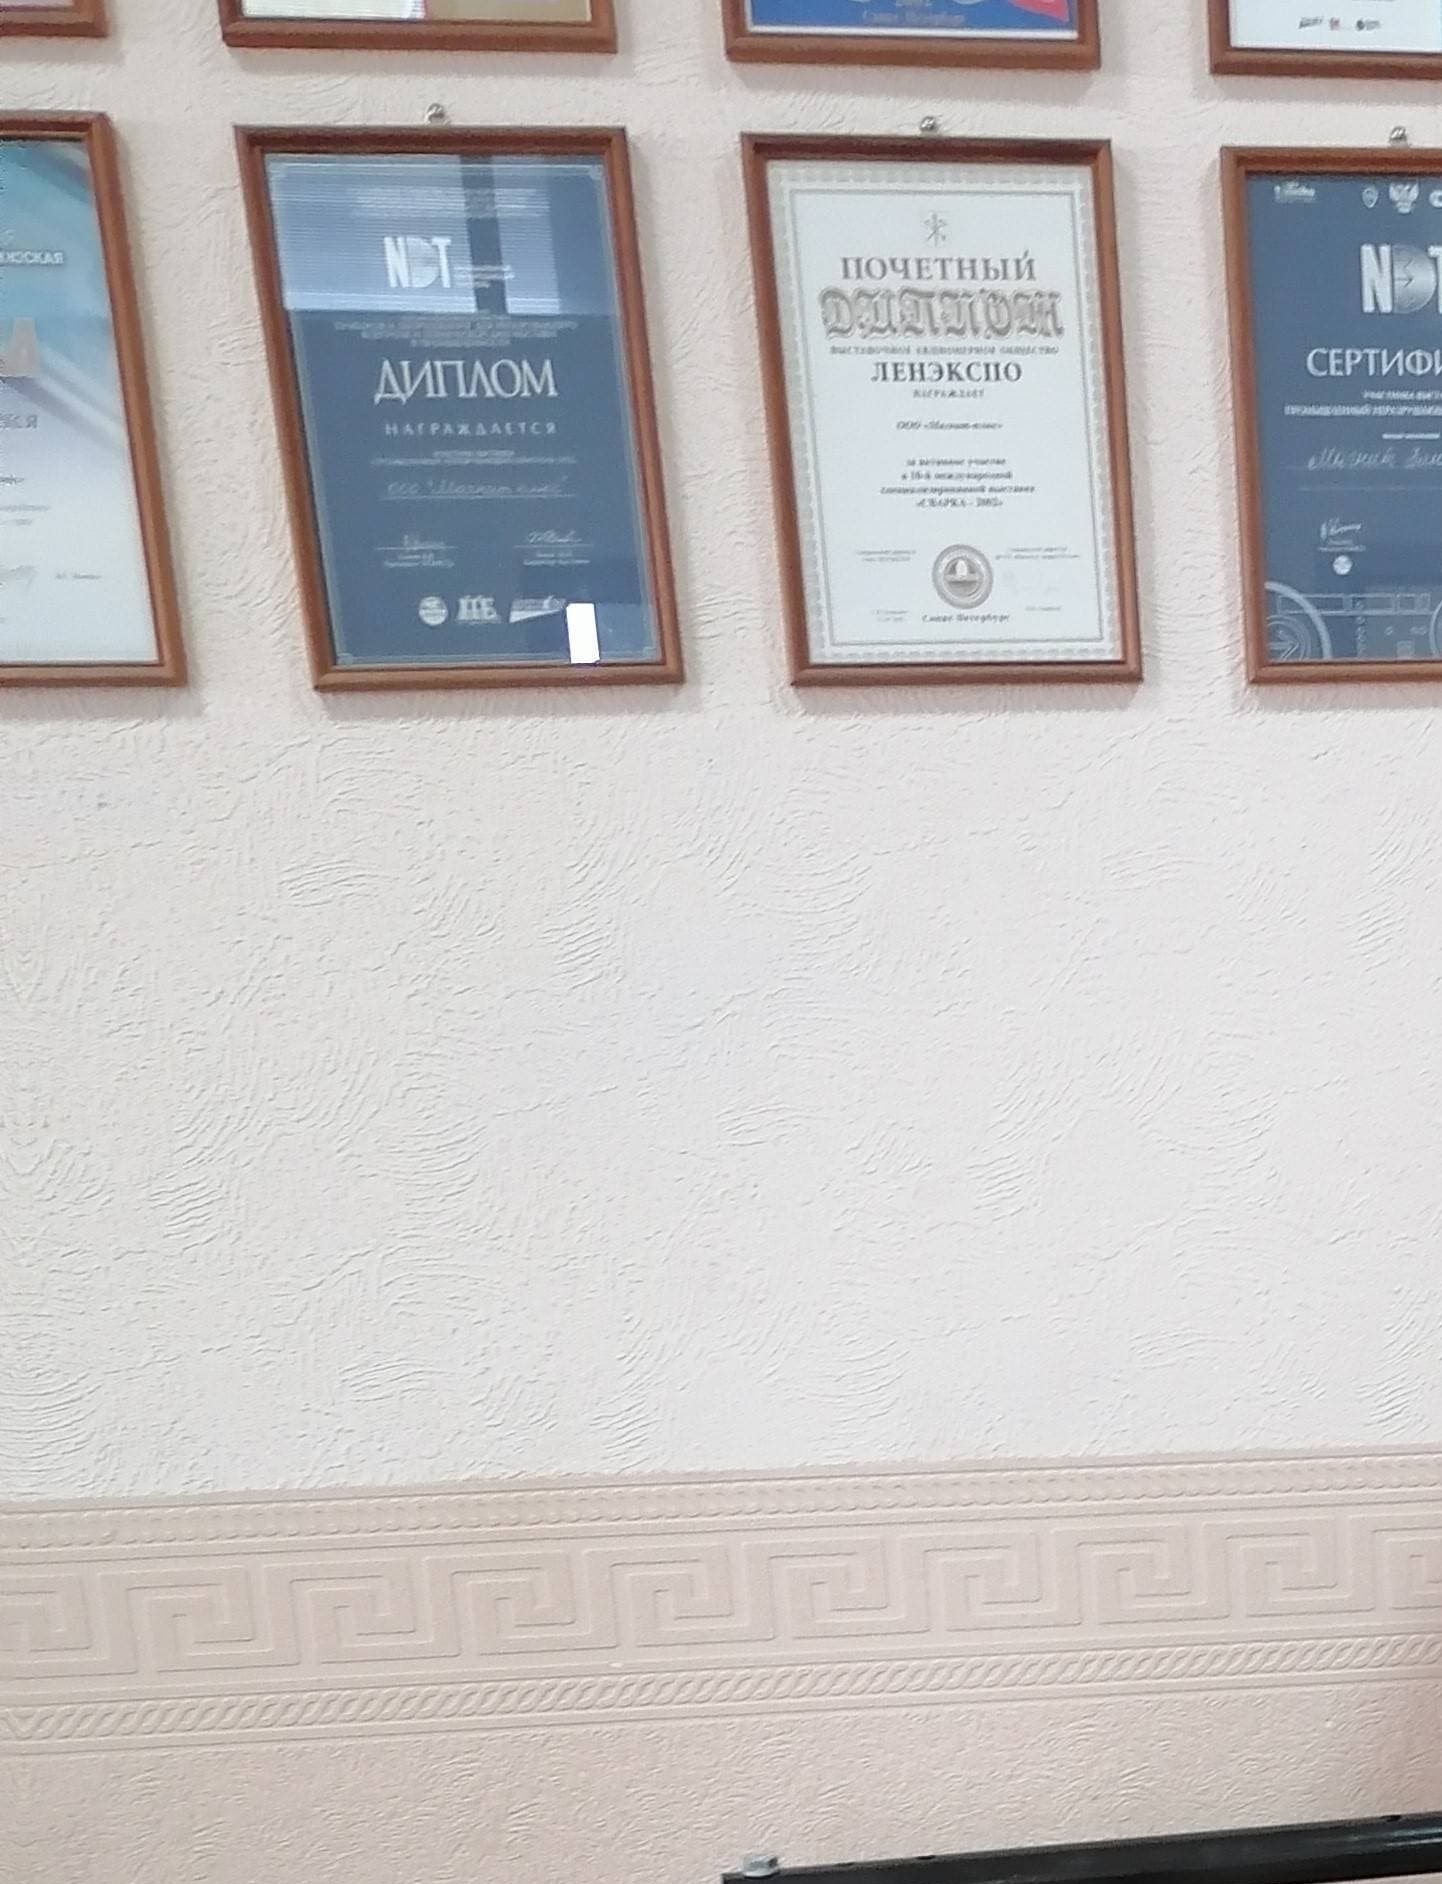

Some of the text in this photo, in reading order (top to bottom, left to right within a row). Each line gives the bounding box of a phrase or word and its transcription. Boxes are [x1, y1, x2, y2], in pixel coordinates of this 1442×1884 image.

[841, 250, 1037, 281] ПОЧЕТНЫЙ
[374, 359, 558, 405] ДИПЛОМ
[871, 361, 1022, 382] ЛЕНЭКСПО
